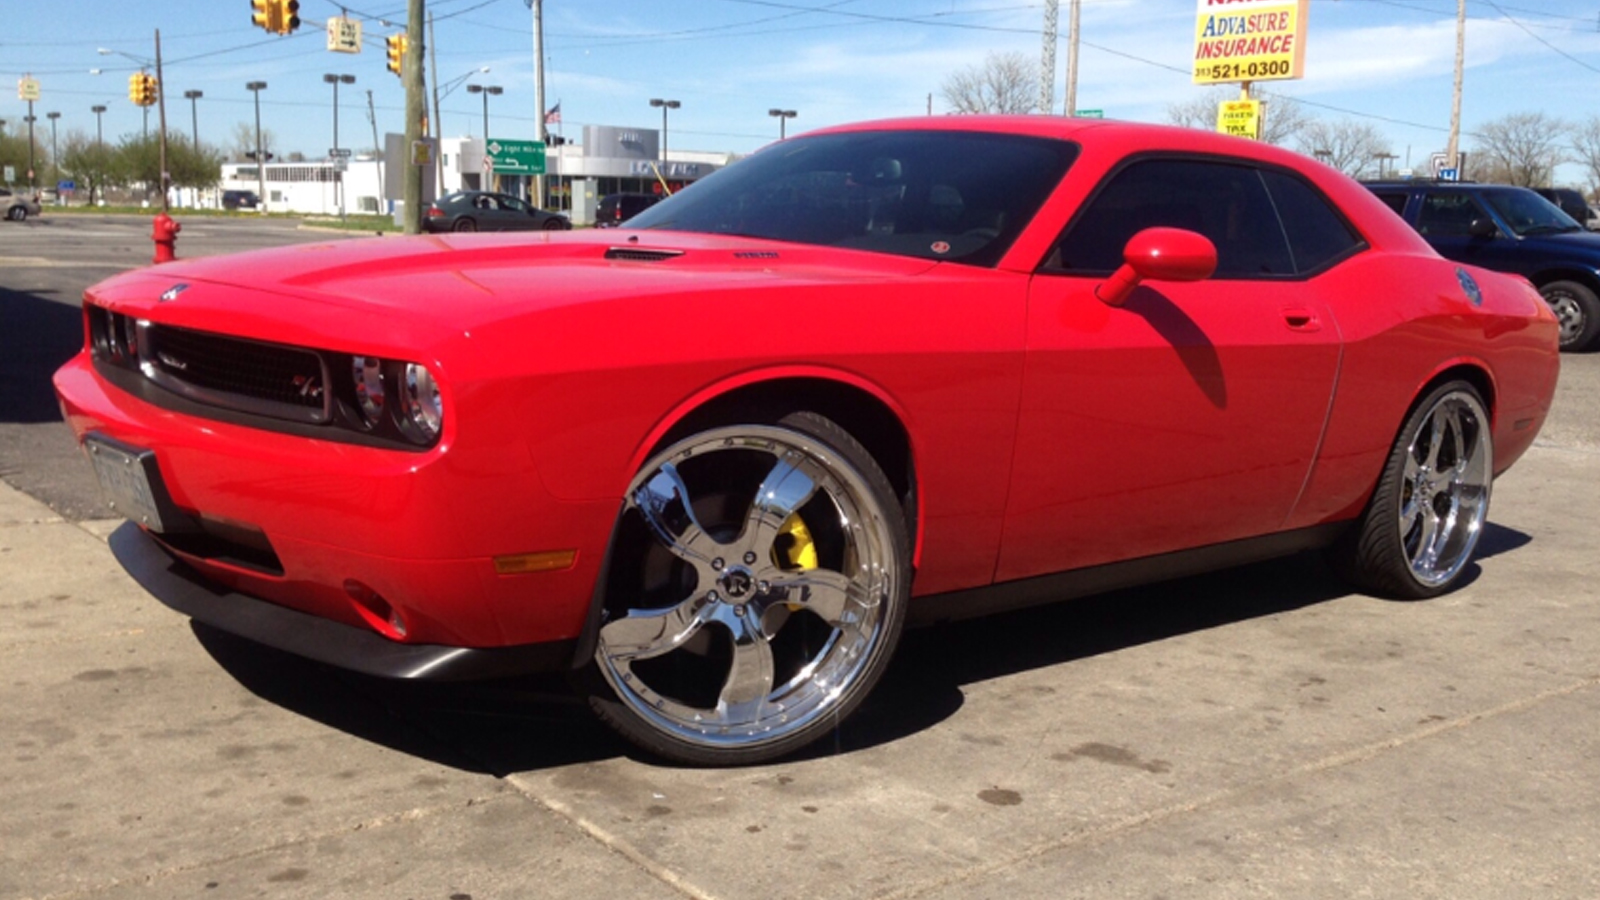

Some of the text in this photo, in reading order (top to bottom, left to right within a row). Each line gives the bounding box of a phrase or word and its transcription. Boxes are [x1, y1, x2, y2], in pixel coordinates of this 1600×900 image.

[1202, 11, 1289, 37] ADVASURE
[1195, 34, 1293, 60] INSURANCE
[1211, 60, 1290, 79] 521-0300
